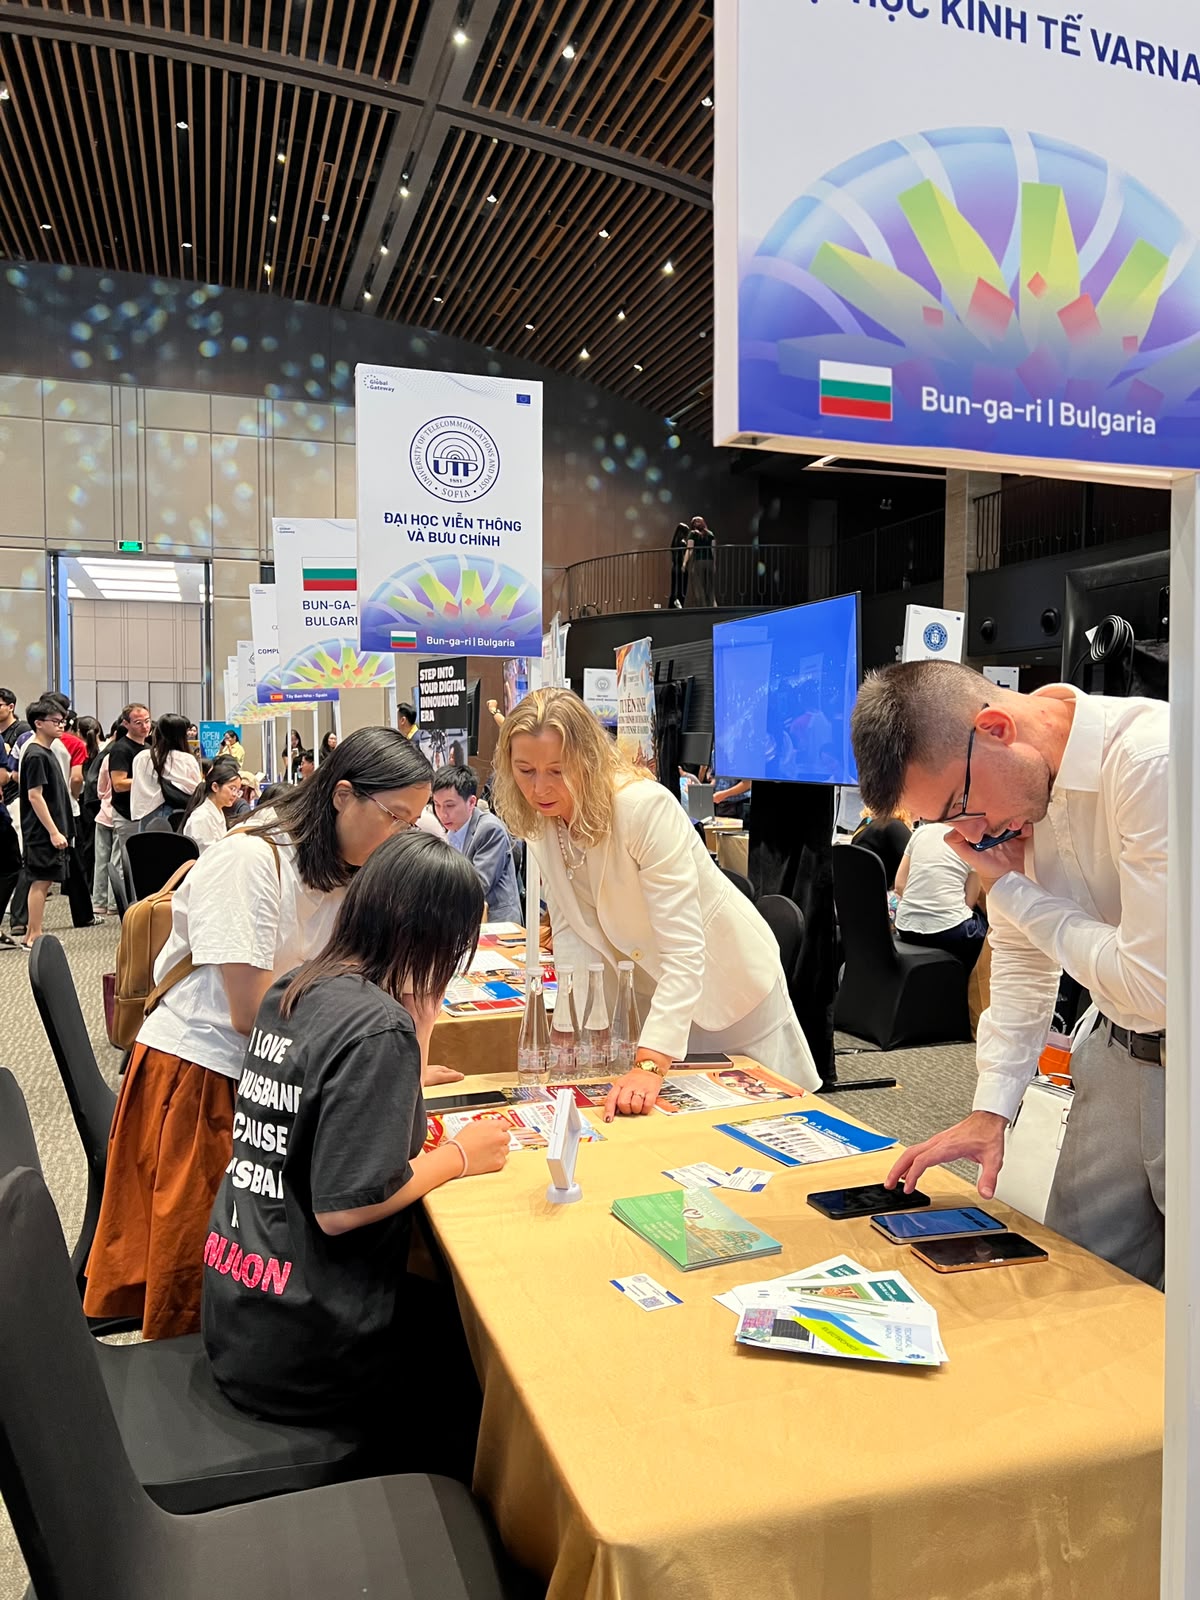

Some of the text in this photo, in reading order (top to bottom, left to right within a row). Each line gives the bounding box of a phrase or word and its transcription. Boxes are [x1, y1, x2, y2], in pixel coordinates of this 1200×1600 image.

[941, 0, 1027, 44] KINH
[1037, 14, 1083, 57] TẾ
[1090, 28, 1200, 86] VARNA
[921, 386, 1042, 424] Bun-ga-ri
[1060, 402, 1156, 436] Bulgaria
[424, 420, 495, 457] TELECOMMUNICATIONS
[414, 445, 433, 487] UNIVERSITY
[433, 459, 479, 477] UTP
[488, 458, 496, 474] AND
[479, 476, 492, 490] POST
[441, 487, 471, 498] SOFIA
[384, 512, 522, 532] ĐẠI HỌC VIỄN THÔNG
[407, 528, 500, 547] VÀ BƯU CHÍNH
[426, 636, 472, 648] Bun-ga-ri
[477, 637, 515, 648] Bulgaria
[420, 665, 454, 681] STEP INTO
[420, 679, 466, 695] YOUR DIGITAL
[420, 694, 459, 708] INNOVATOR
[420, 710, 435, 722] ERA
[201, 731, 220, 740] OPEN
[248, 1026, 293, 1065] I LOVE
[232, 1111, 288, 1156] CAUSE
